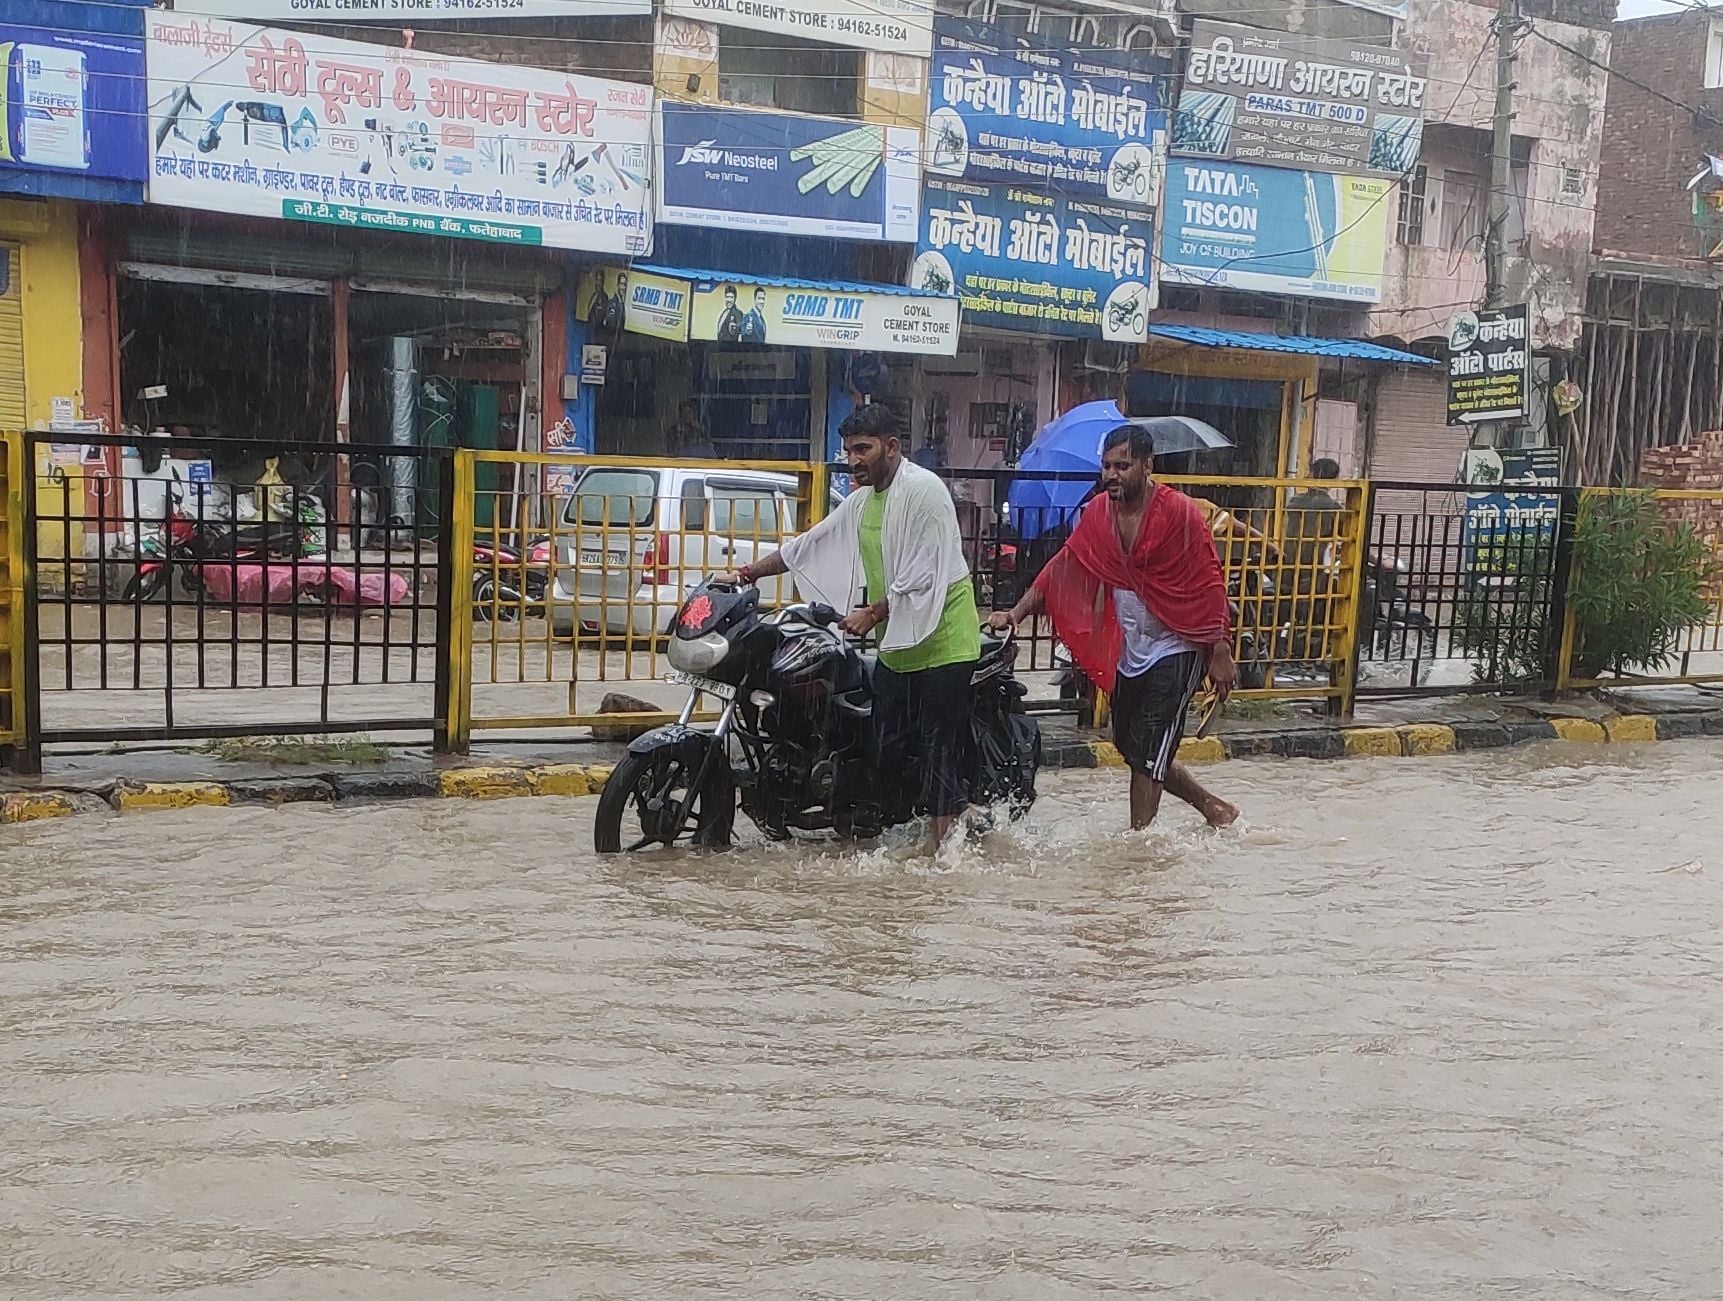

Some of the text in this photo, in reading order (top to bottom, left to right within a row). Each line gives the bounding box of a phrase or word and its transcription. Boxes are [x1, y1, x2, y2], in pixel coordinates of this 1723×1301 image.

[736, 1, 785, 22] CEMENT
[789, 10, 827, 29] STORE
[837, 17, 907, 41] 94162-51524
[1188, 37, 1288, 90] हरियाणा
[1289, 59, 1374, 100] आयरन
[1377, 63, 1428, 108] स्टोर
[245, 35, 598, 138] सेठी टूल्स & आयरन स्टोर
[943, 57, 1149, 141] कन्हैया ऑटो मोबाईल
[1248, 95, 1365, 122] PARAS TMT 500 D
[331, 136, 355, 150] PYE
[198, 160, 210, 179] पर
[724, 151, 778, 171] Neosteel
[705, 170, 720, 181] Pure
[721, 172, 735, 183] TMT
[1184, 166, 1238, 197] TATA
[413, 219, 435, 229] PNB
[1183, 199, 1258, 231] TISCON
[929, 200, 1147, 280] कन्हैया ऑटो मोबाईल
[1180, 243, 1197, 255] JOY
[1213, 246, 1256, 260] BUILDING
[632, 284, 684, 311] SRMB TMT
[782, 293, 864, 320] SRMB TMT
[903, 304, 932, 317] GOYAL
[817, 328, 860, 341] WINGRIP
[883, 318, 951, 334] CEMENT STORE
[1479, 313, 1525, 342] कन्हैया
[1450, 350, 1484, 376] ऑटो
